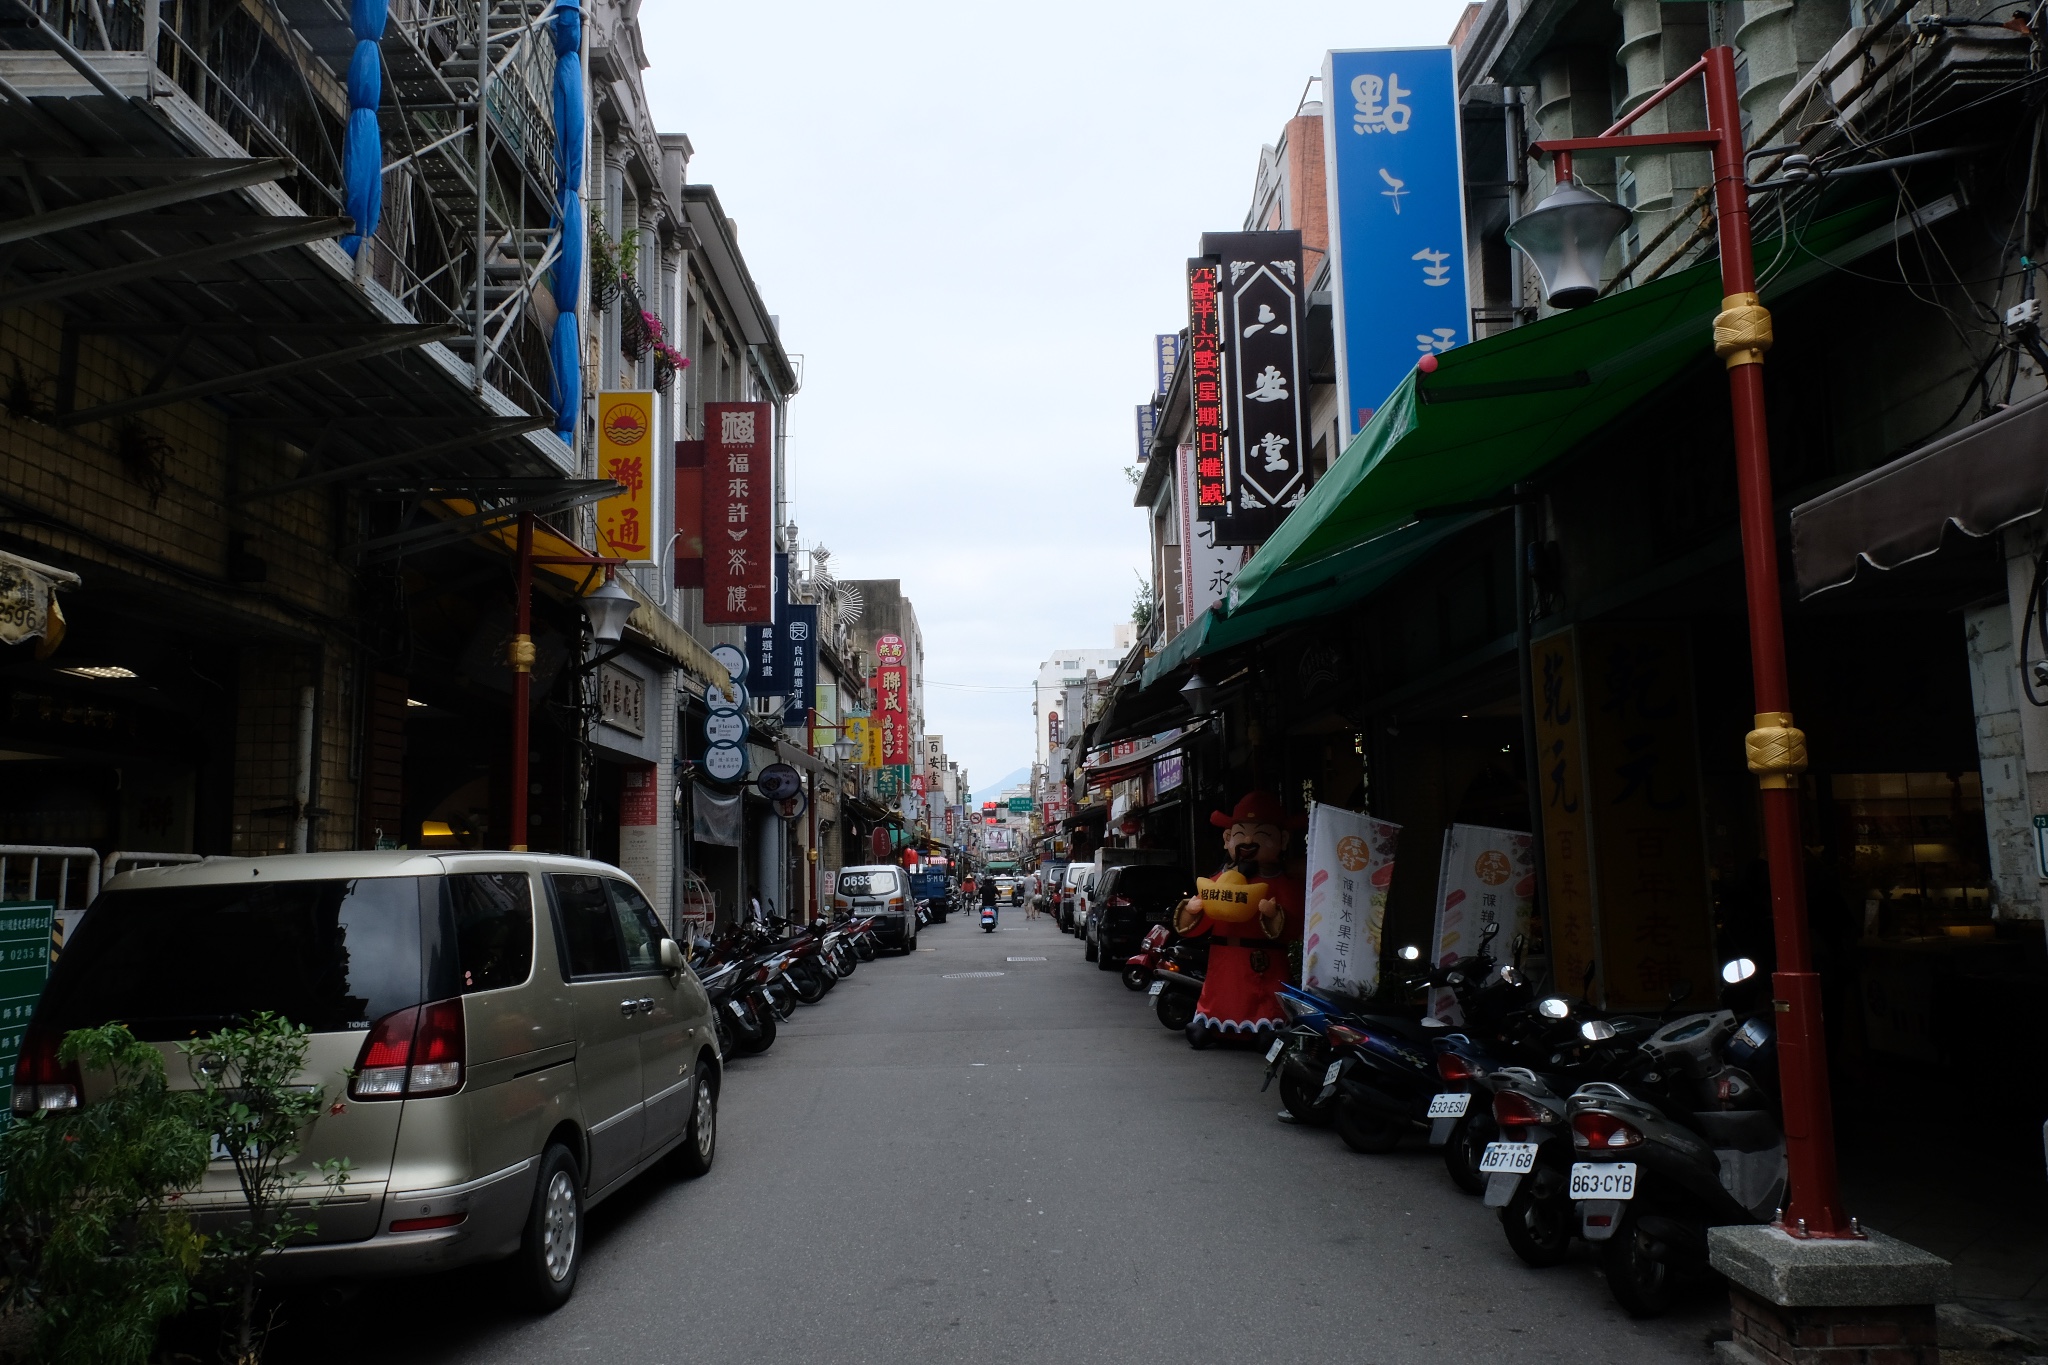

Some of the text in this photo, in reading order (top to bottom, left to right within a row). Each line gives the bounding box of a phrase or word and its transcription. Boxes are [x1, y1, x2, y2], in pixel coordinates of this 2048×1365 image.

[1243, 304, 1290, 473] 六安堂
[607, 457, 646, 552] 聯通
[727, 453, 749, 522] 福來許
[762, 627, 773, 677] 嚴選計畫
[879, 644, 902, 656] 燕窩
[794, 646, 803, 710] 良品嚴選計畫
[882, 671, 902, 713] 聯成
[928, 741, 940, 785] 百安堂
[1201, 889, 1248, 904] 招財進寶
